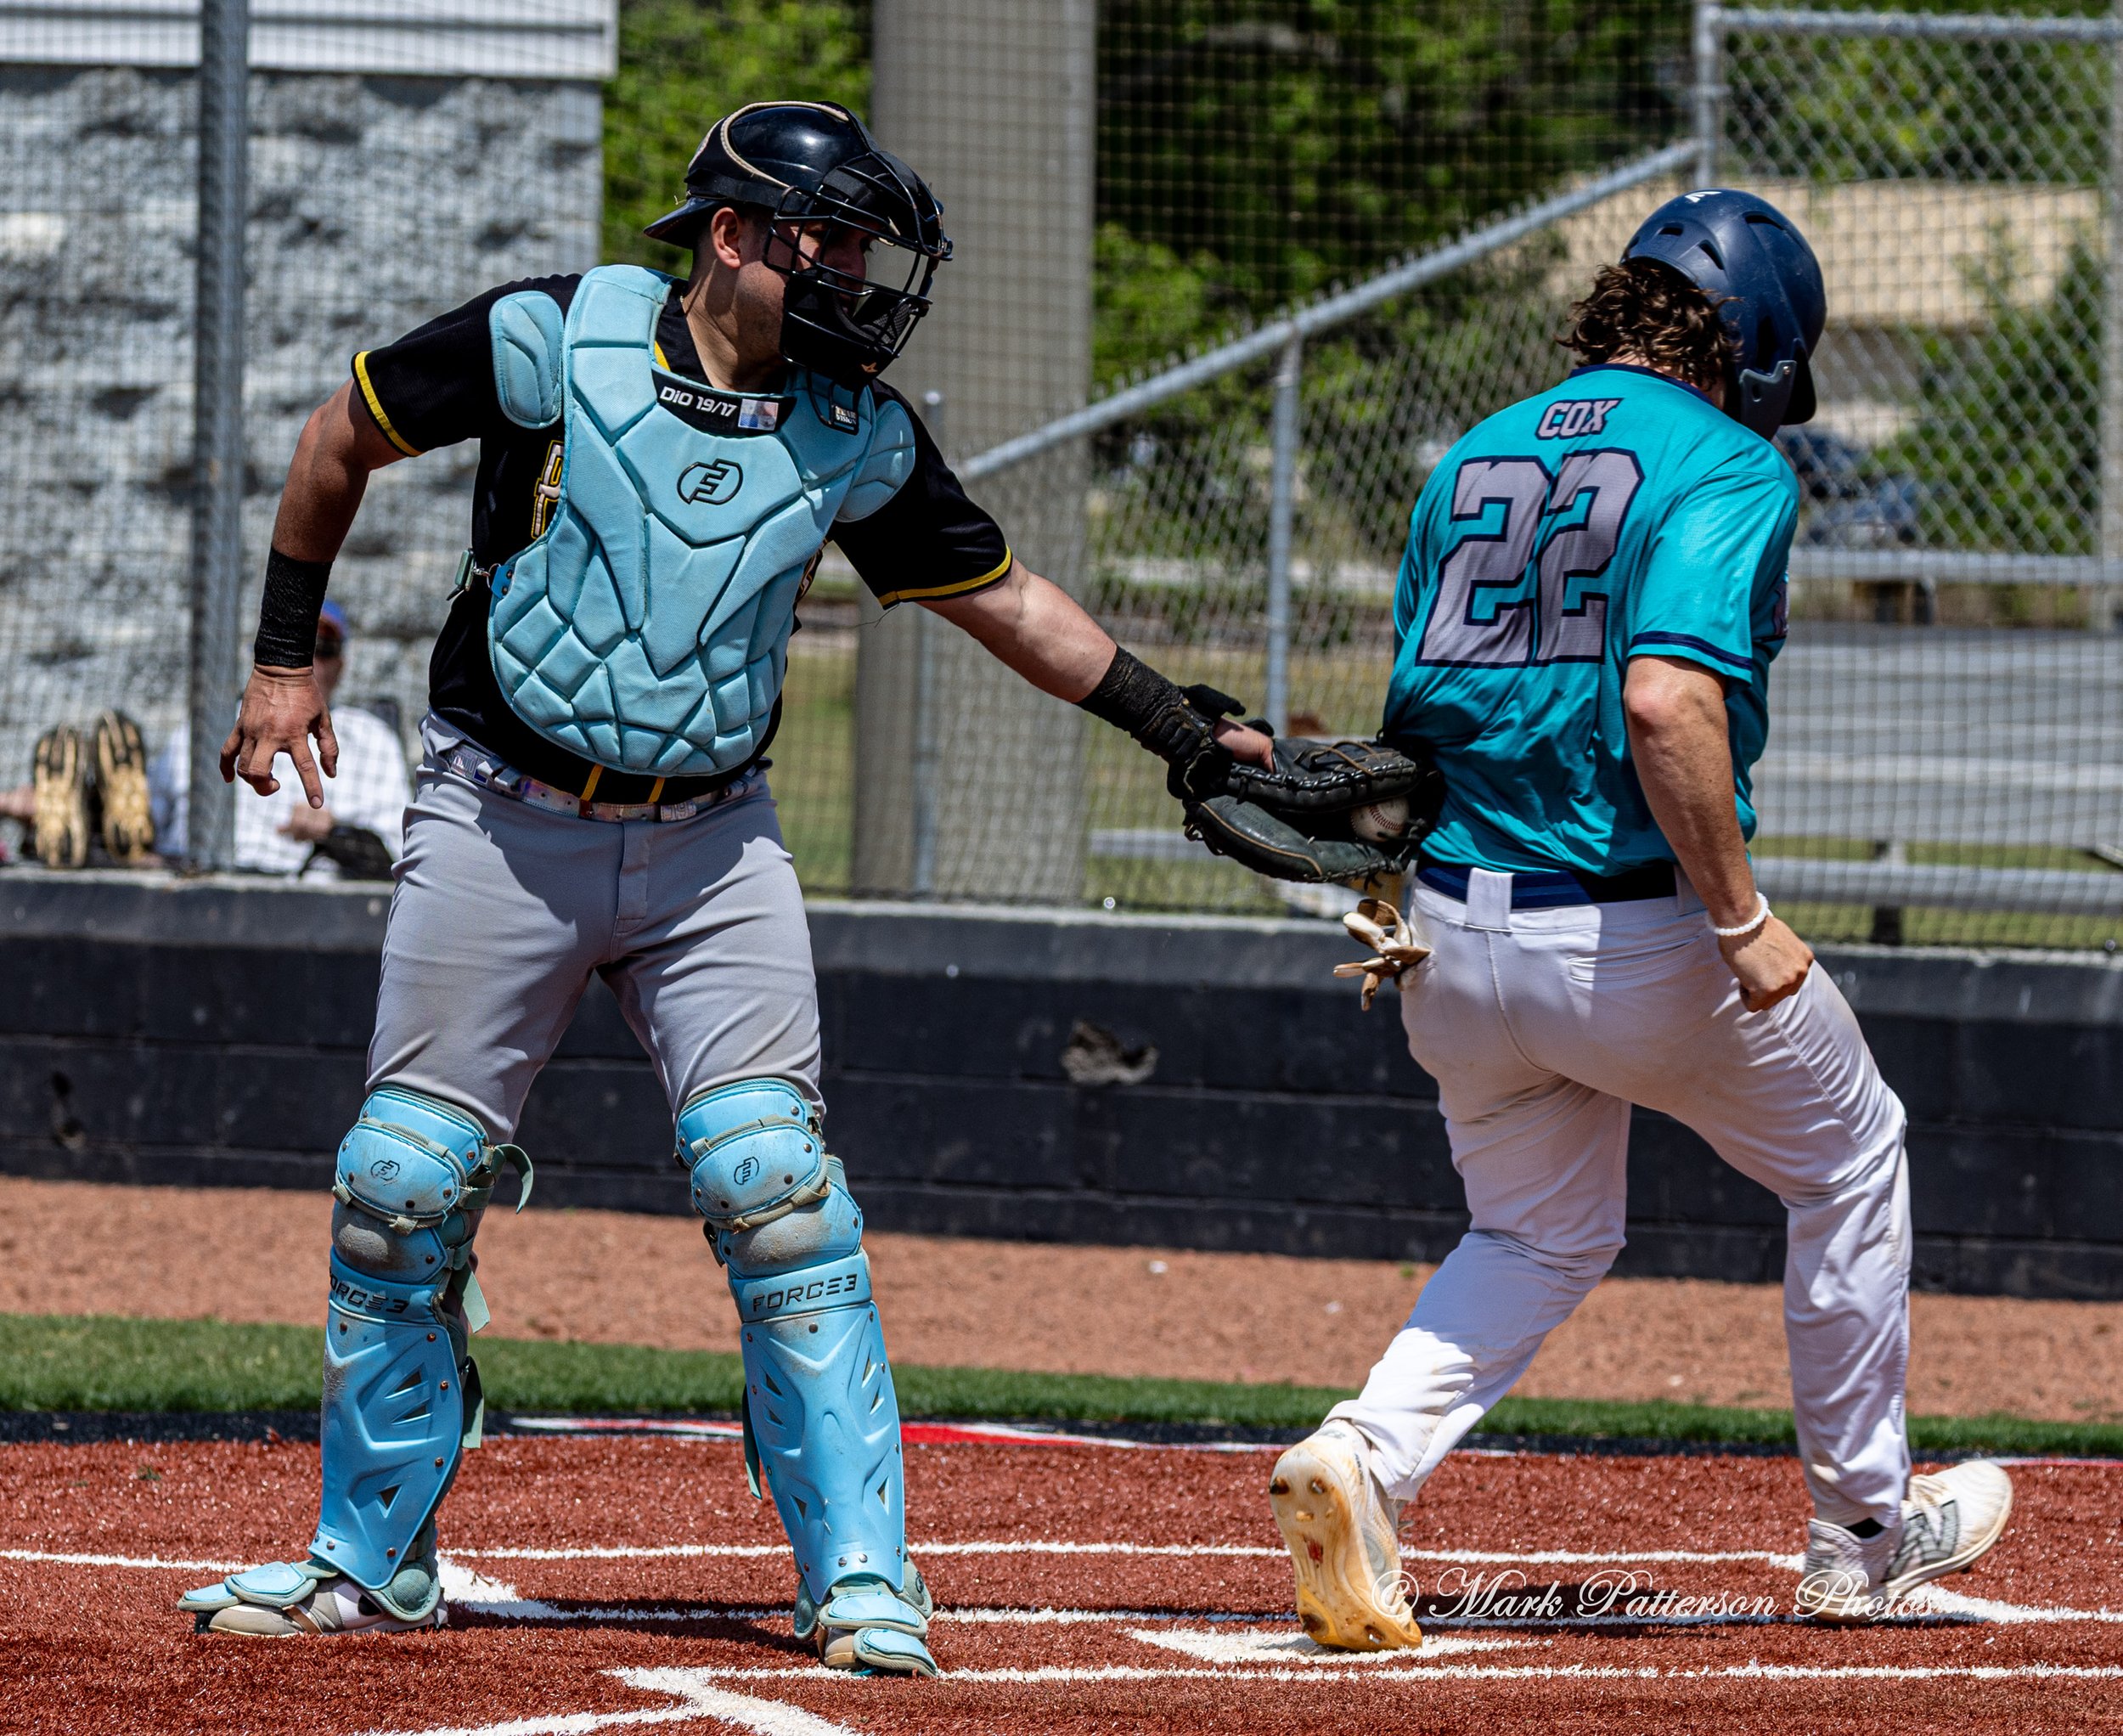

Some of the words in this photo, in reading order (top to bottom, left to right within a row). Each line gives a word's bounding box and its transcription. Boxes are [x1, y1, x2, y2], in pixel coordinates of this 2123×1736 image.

[695, 395, 738, 418] 19/17
[1535, 397, 1624, 440] COX
[1415, 447, 1646, 670] 22
[752, 1273, 858, 1312] FORCE3
